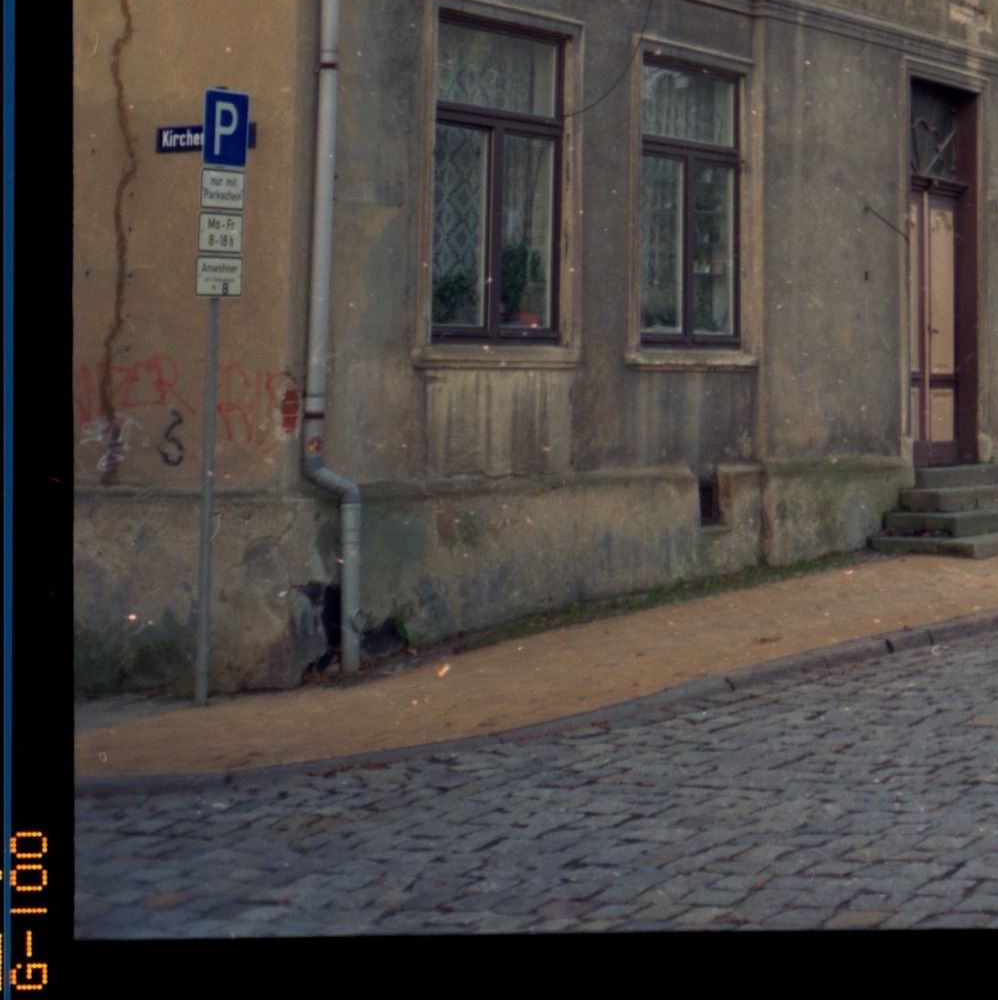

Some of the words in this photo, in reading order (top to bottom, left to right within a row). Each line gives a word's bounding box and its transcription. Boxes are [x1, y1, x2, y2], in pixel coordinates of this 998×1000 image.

[214, 101, 238, 156] P
[202, 187, 242, 202] Parkschein
[201, 262, 238, 274] Anwohner
[9, 831, 48, 991] G-100
